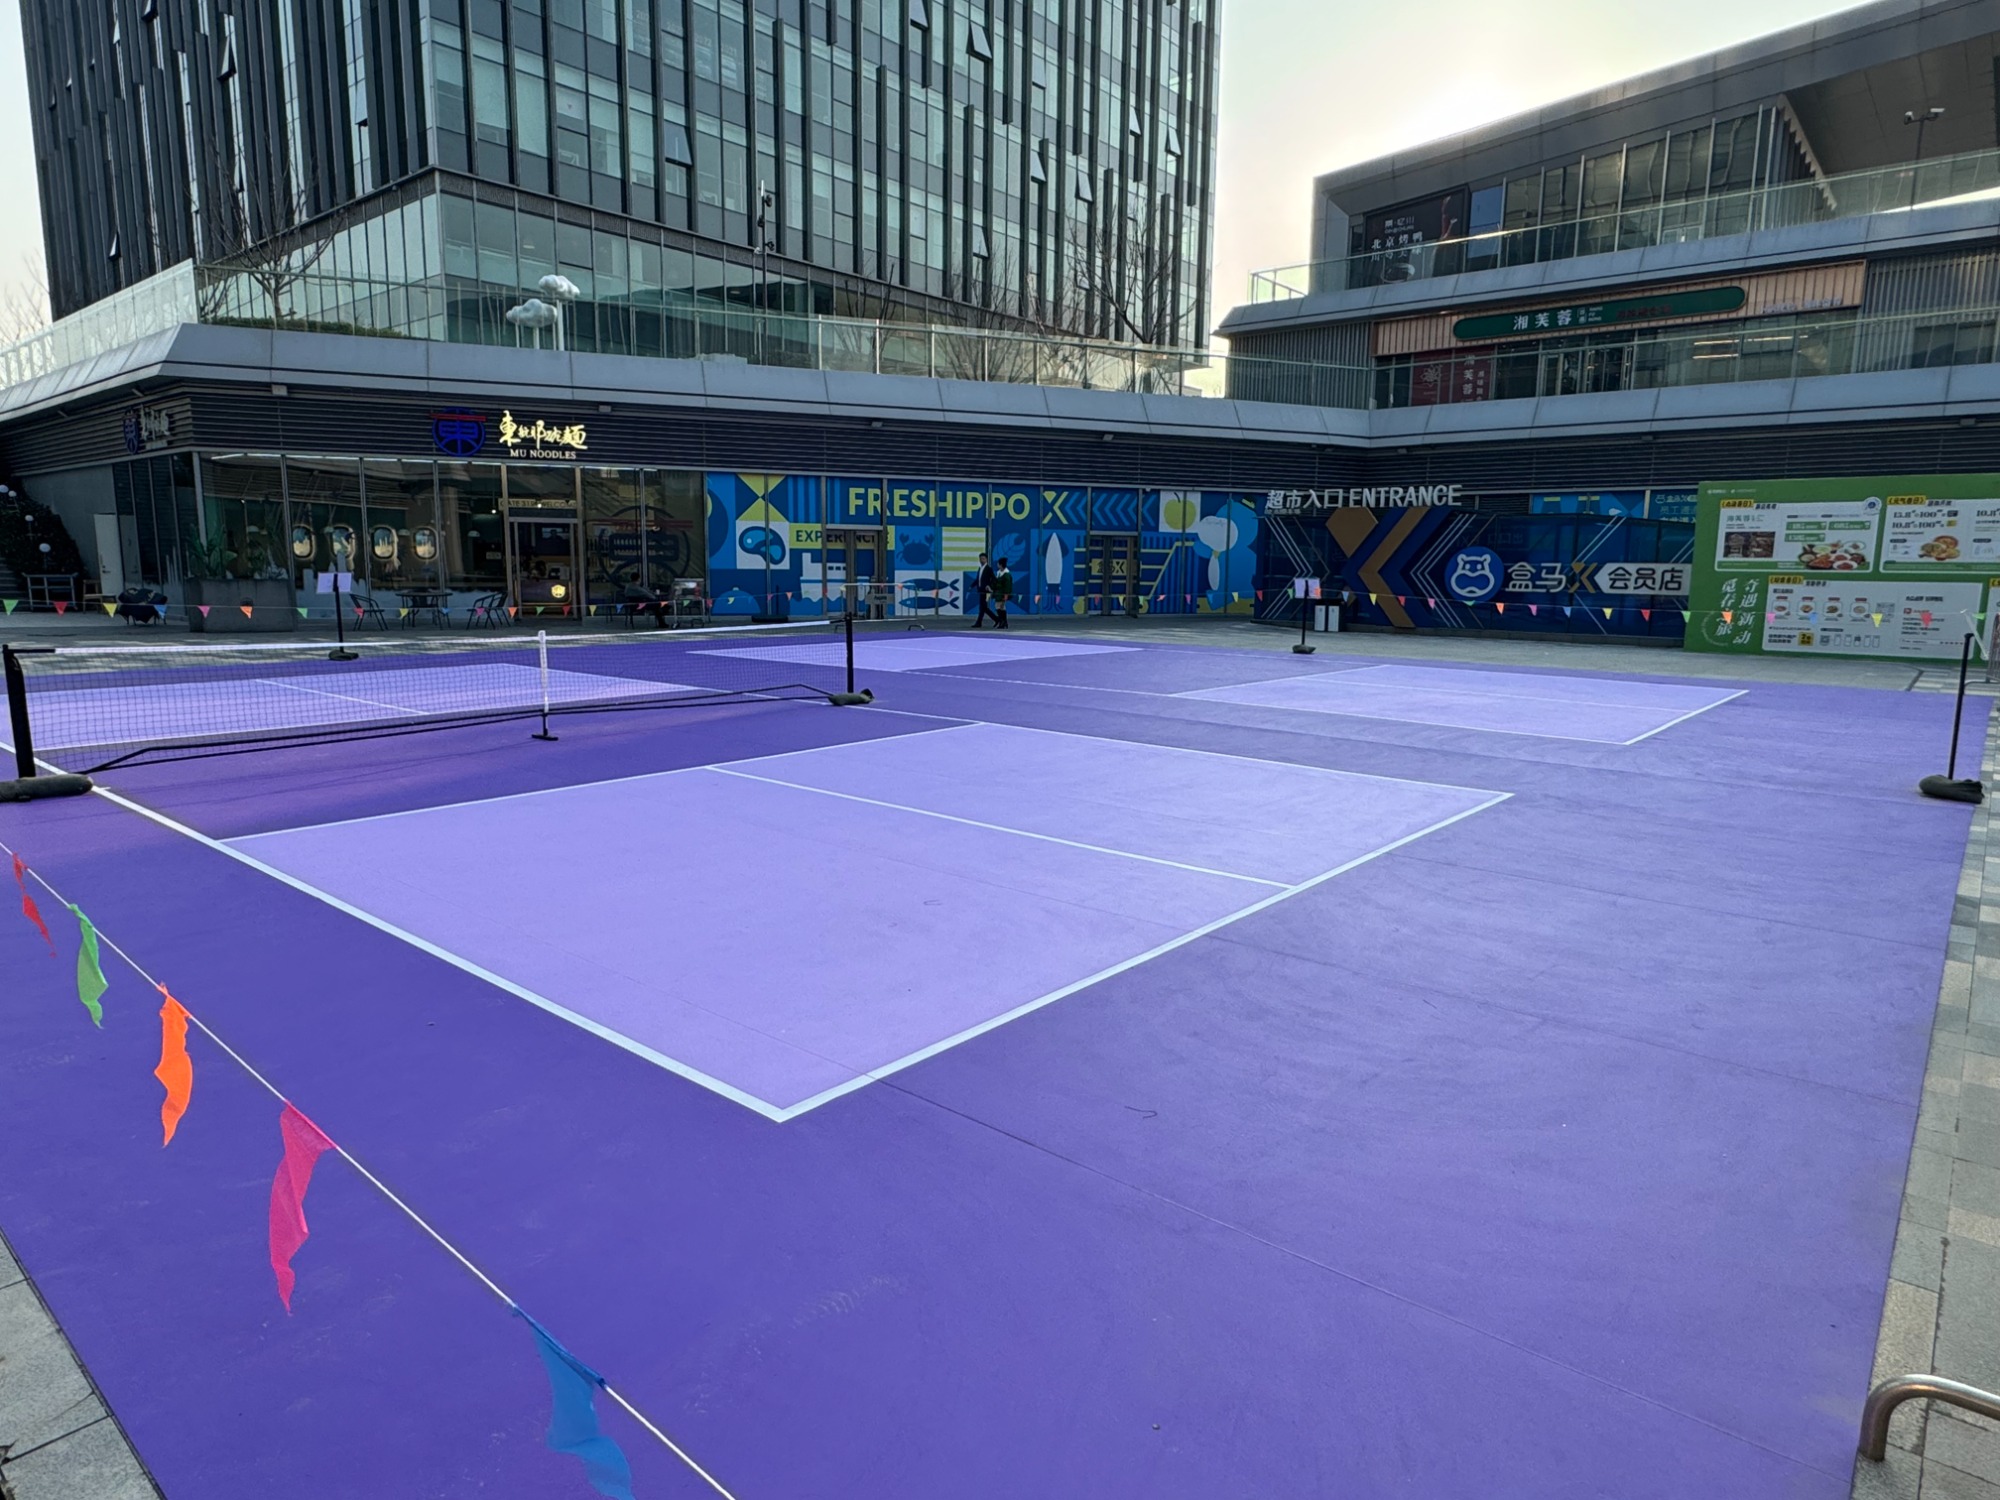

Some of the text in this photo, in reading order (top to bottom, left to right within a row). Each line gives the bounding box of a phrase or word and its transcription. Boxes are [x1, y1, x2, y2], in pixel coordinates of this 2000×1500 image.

[1513, 309, 1572, 330] 湘芙蓉
[510, 449, 576, 459] MU NOODLES
[848, 487, 1030, 520] FRESHIPPO
[1265, 488, 1344, 509] 超市入口
[1349, 485, 1463, 508] ENTRANCE
